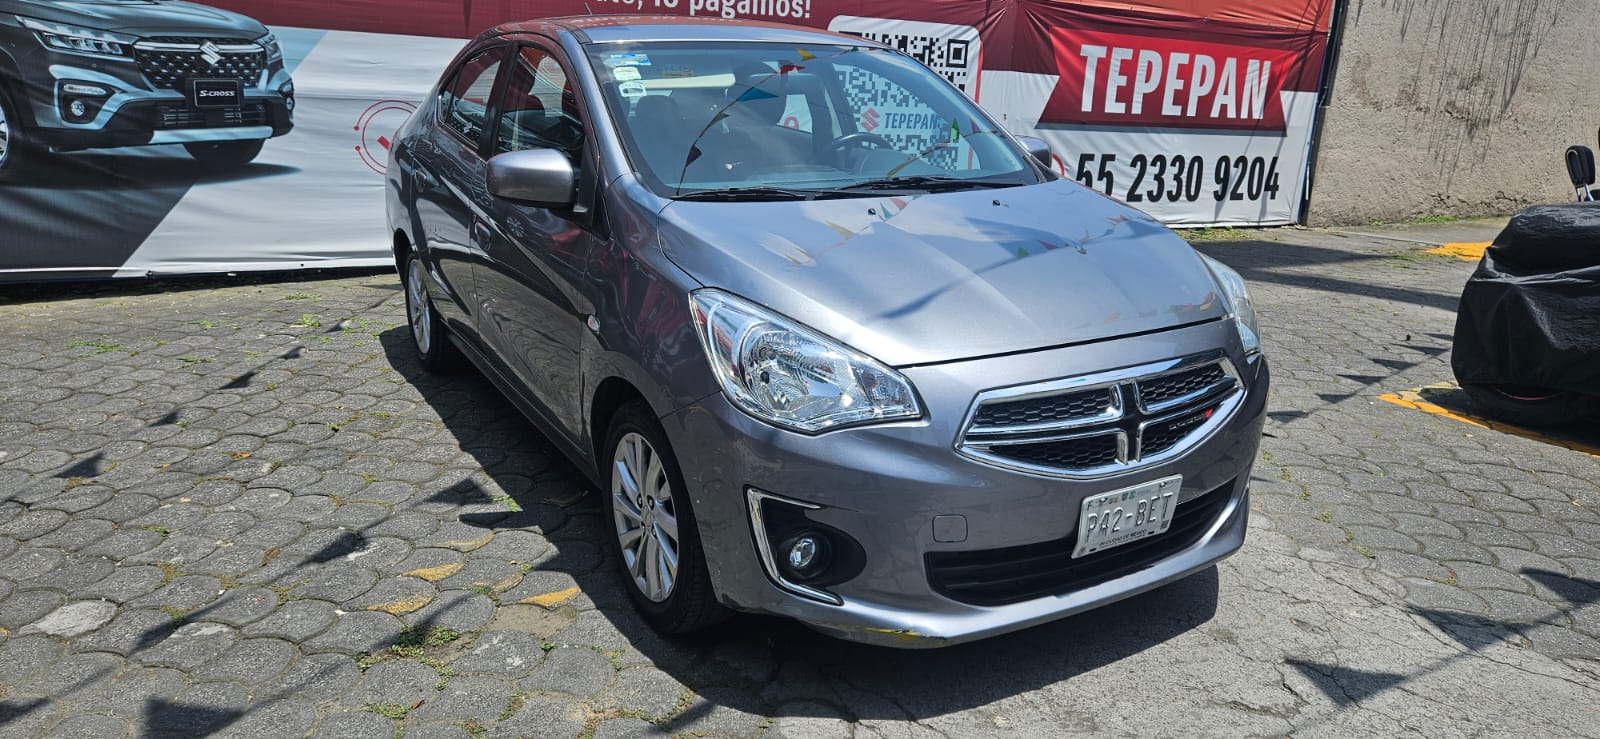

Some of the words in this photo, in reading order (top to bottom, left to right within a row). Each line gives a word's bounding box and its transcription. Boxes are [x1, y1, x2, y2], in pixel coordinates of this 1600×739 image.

[689, 0, 811, 19] pagamos!
[1080, 44, 1272, 120] TEPEPAN
[885, 112, 938, 130] TEPEPAN
[1076, 153, 1116, 196] 55
[1126, 153, 1204, 202] 2330
[1213, 155, 1279, 202] 9204
[1086, 492, 1173, 542] P42-BET
